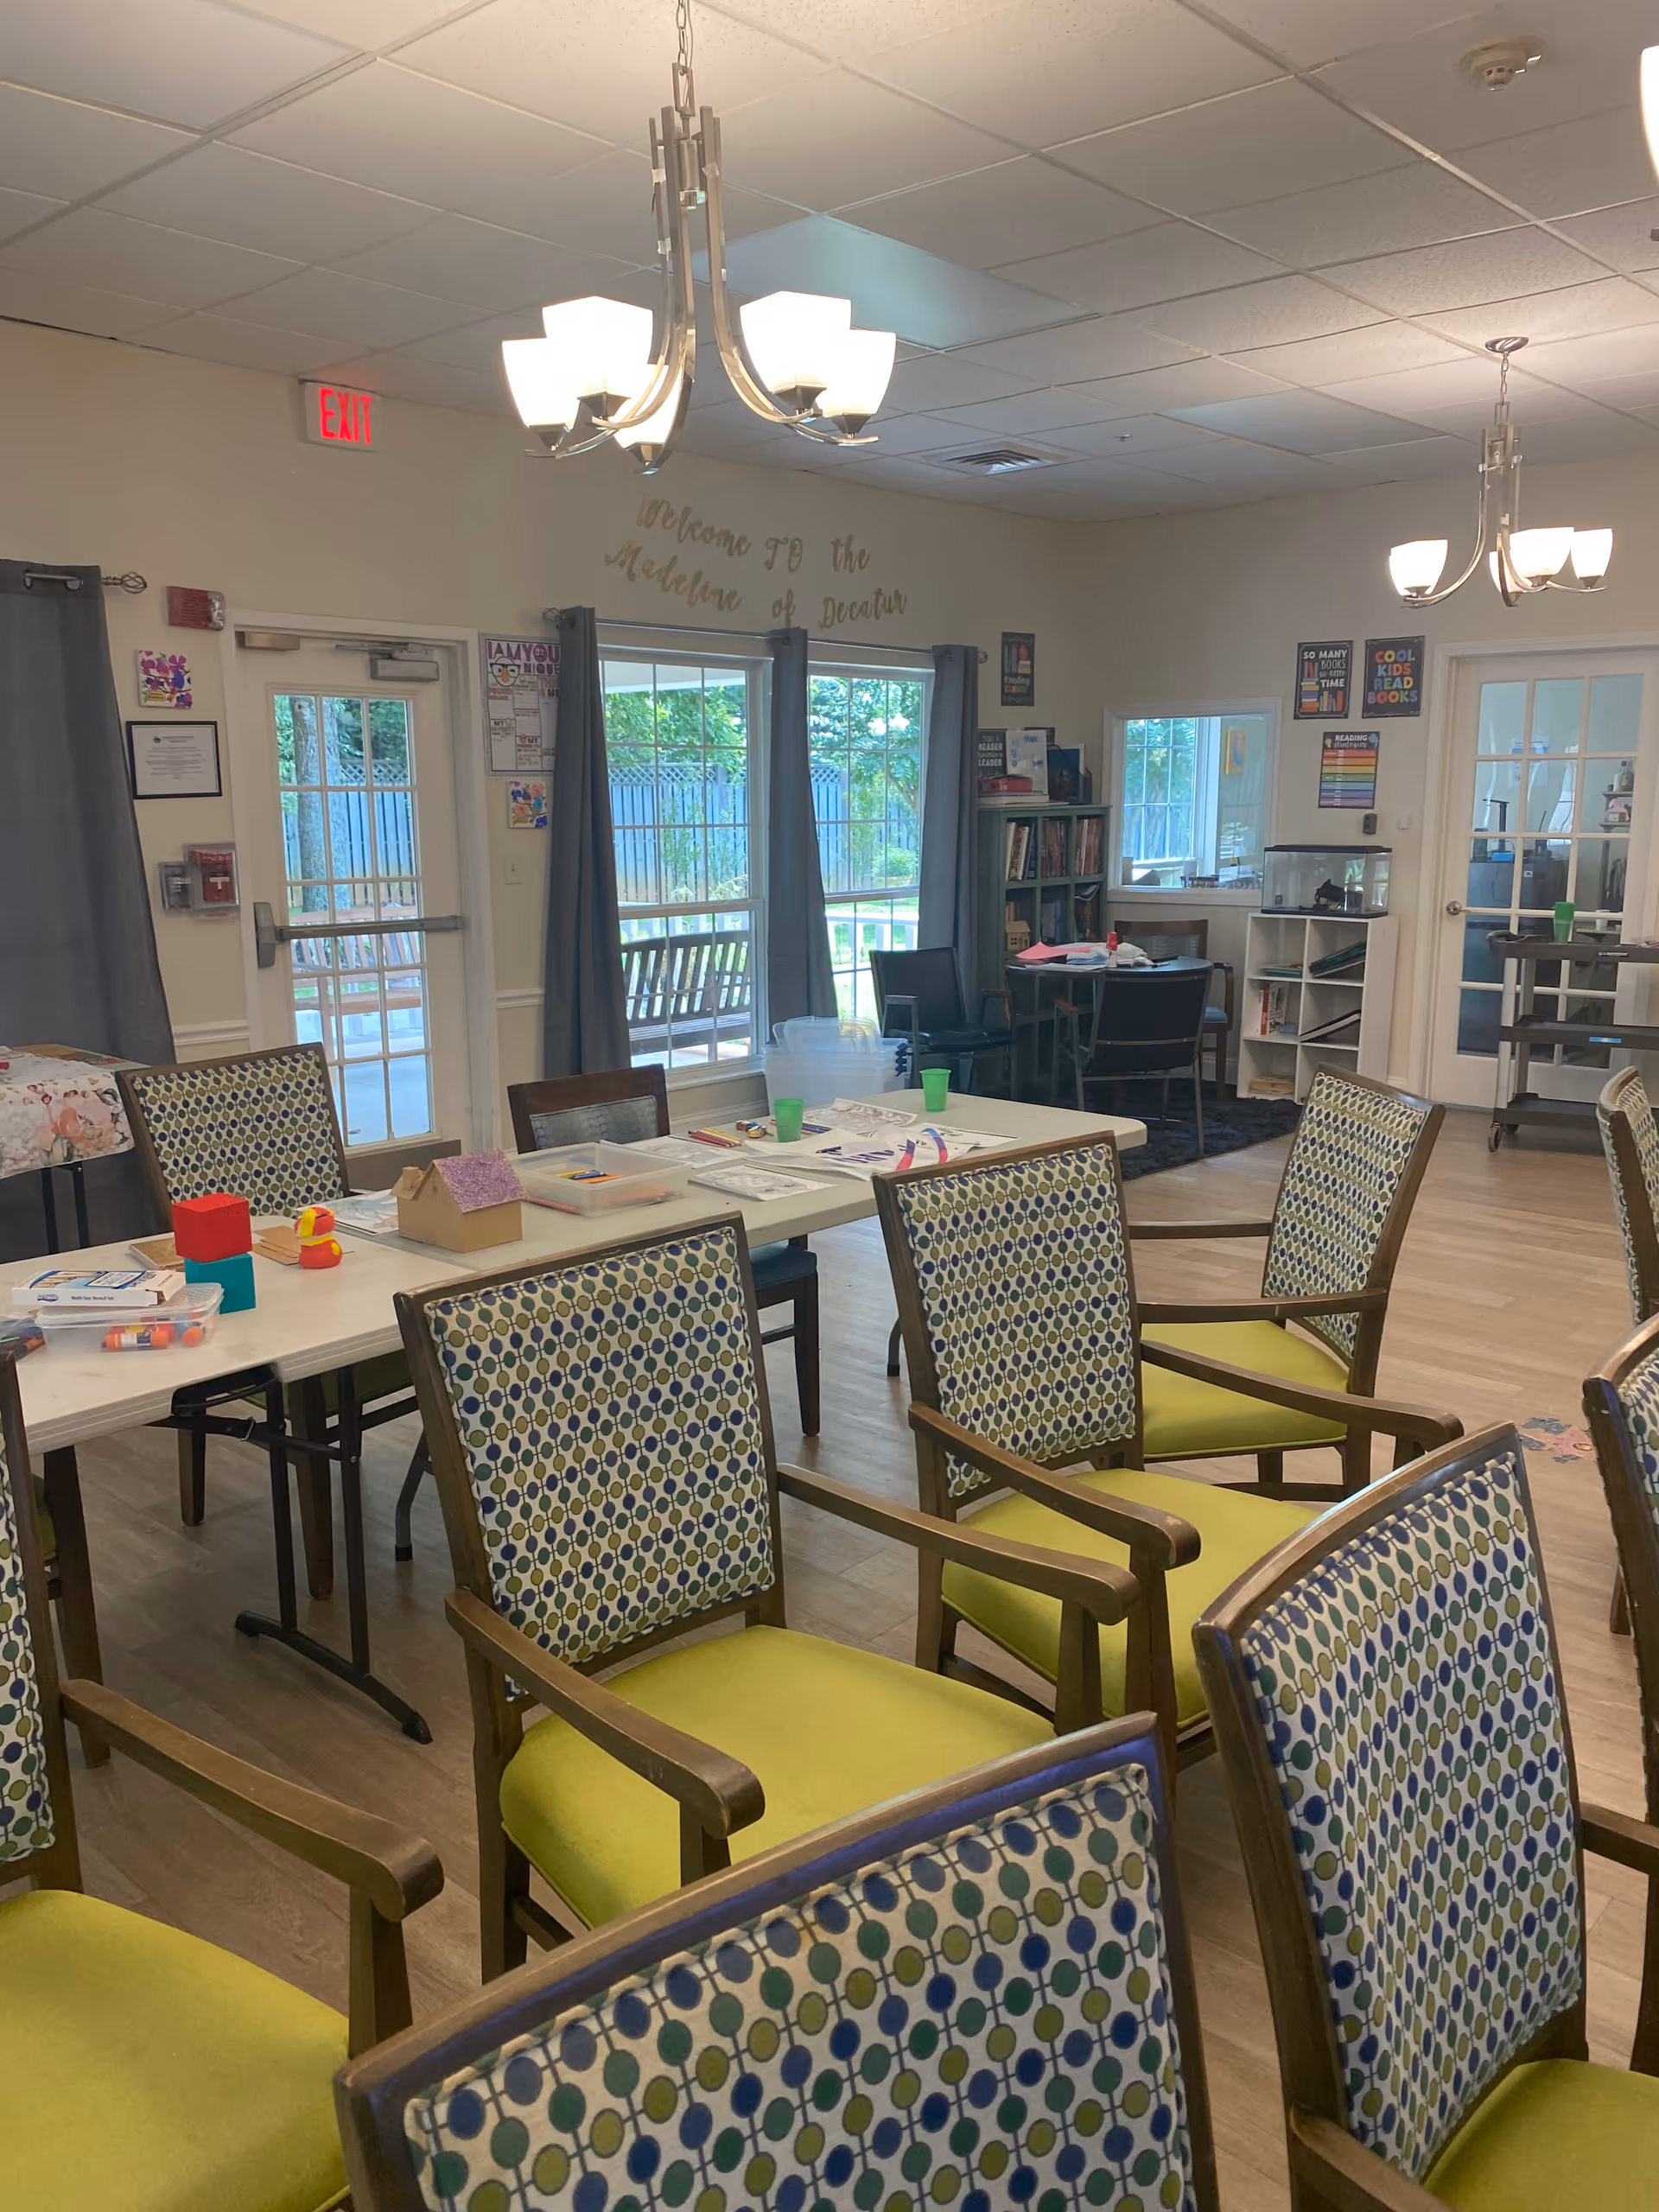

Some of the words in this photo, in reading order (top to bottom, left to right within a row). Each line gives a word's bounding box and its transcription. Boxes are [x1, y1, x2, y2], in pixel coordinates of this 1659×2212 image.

[319, 386, 373, 445] EXIT
[637, 493, 752, 556] Welcome
[830, 535, 871, 574] the
[605, 540, 742, 611] Madeline
[772, 588, 796, 627] of
[818, 588, 906, 630] Decatur
[1303, 651, 1316, 659] SO
[1319, 650, 1348, 659] MANY
[1376, 649, 1415, 664] COOL
[1321, 659, 1346, 670] BOOKS
[1377, 663, 1412, 677] KIDS
[1320, 678, 1344, 688] TIME
[1374, 676, 1414, 690] READ
[1368, 690, 1417, 704] BOOKS
